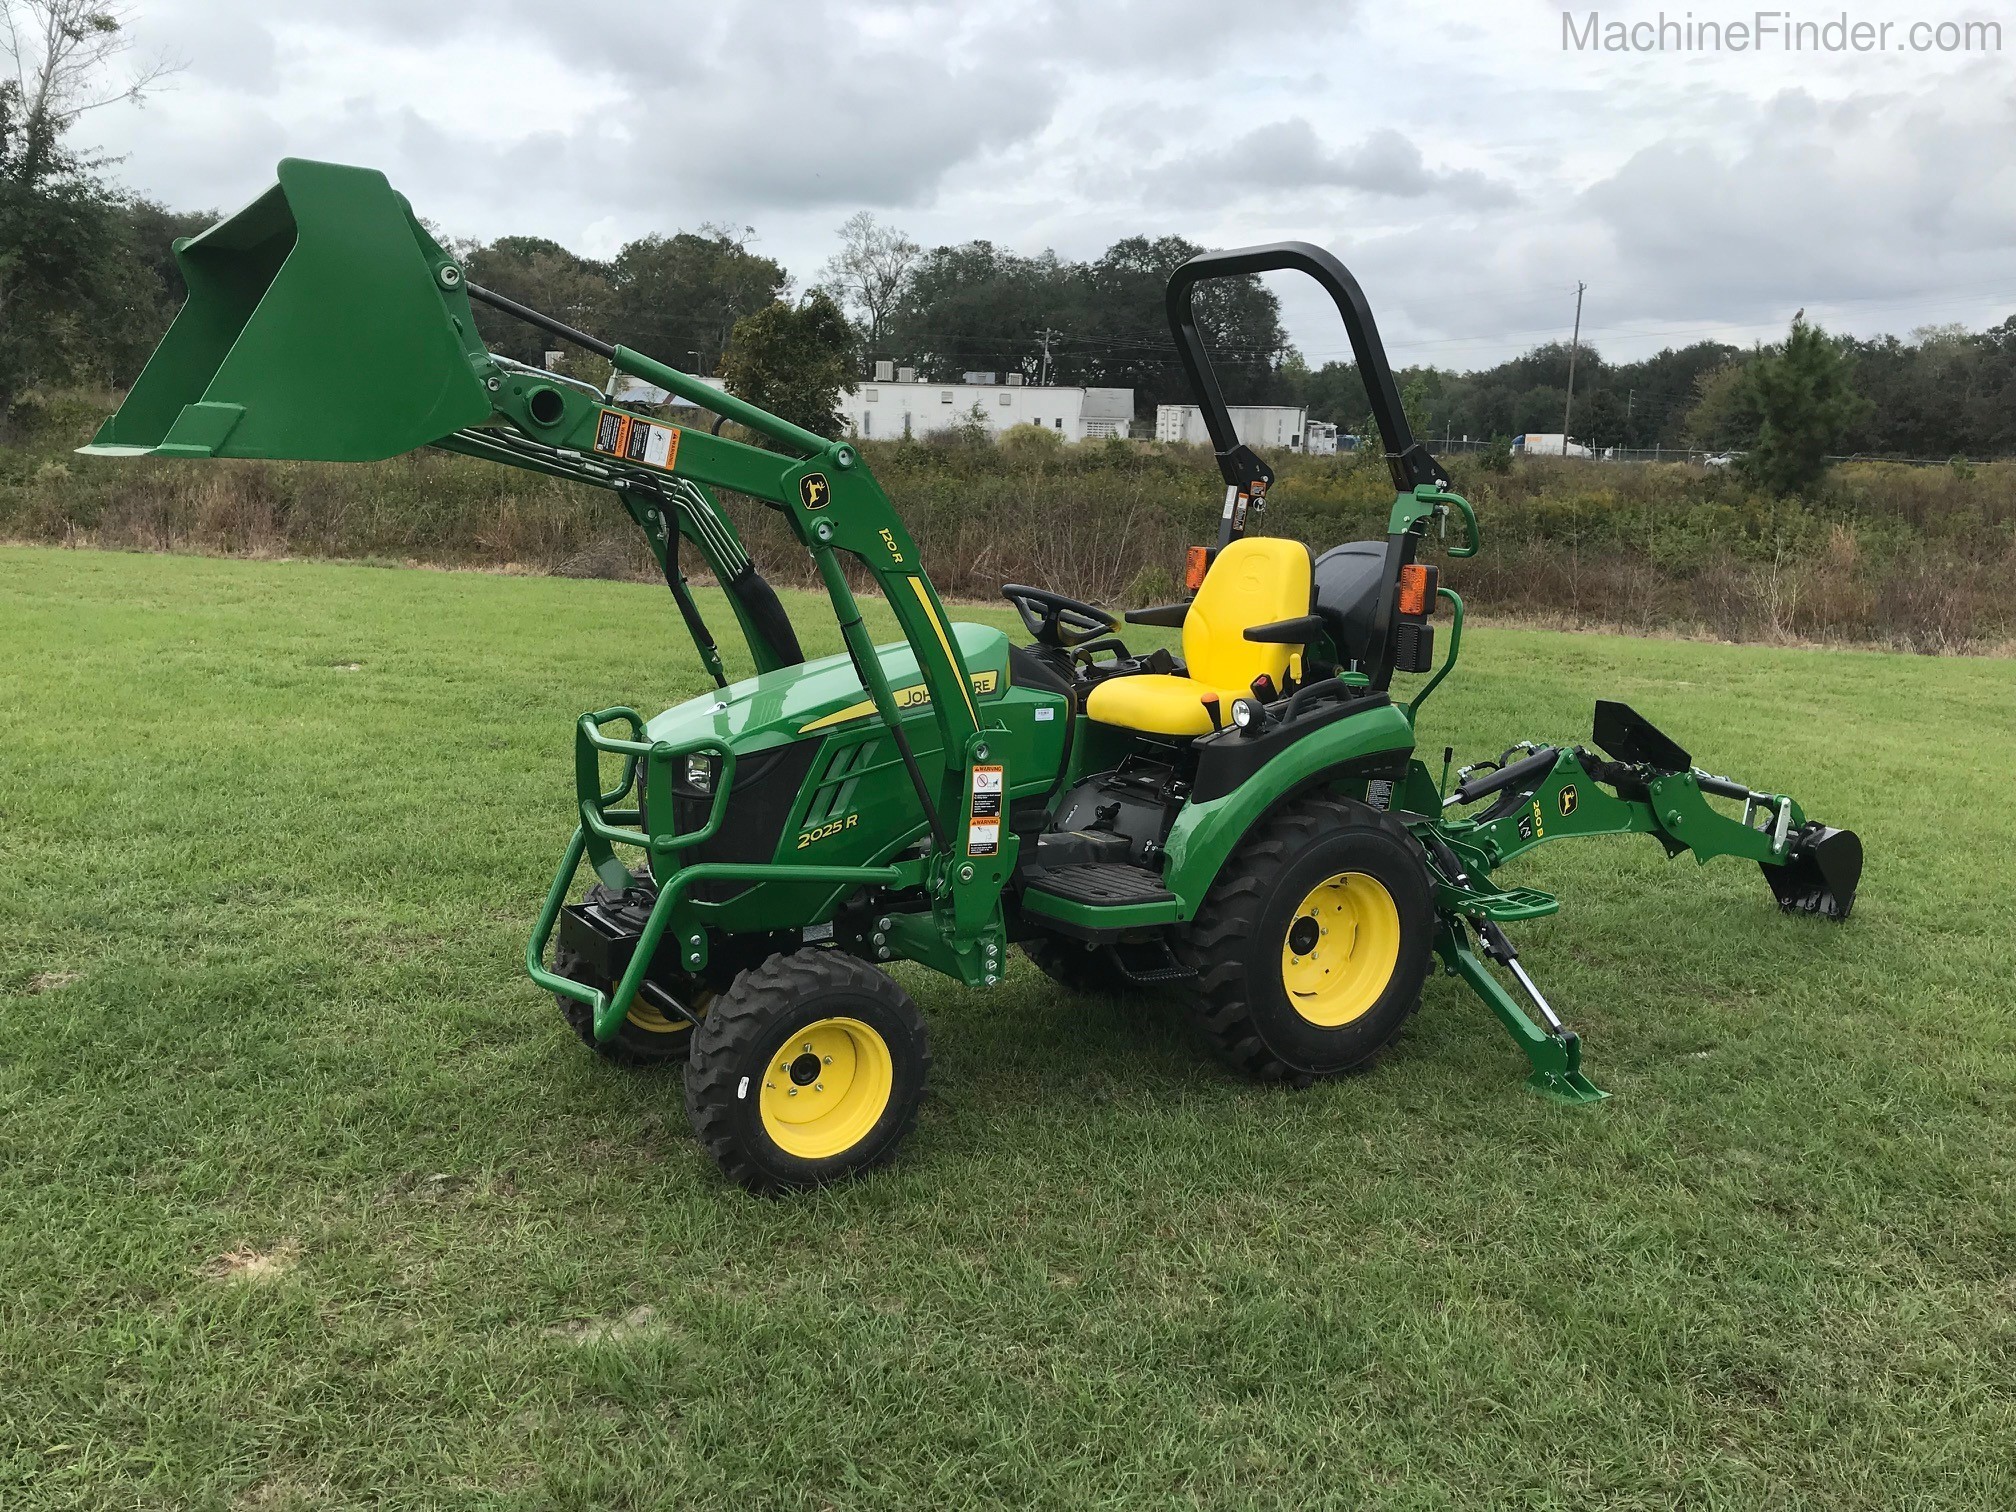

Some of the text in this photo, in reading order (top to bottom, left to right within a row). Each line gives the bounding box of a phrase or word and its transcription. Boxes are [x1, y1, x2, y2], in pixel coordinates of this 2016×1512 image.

[617, 425, 627, 453] WARNING
[668, 440, 677, 466] WARNING
[878, 527, 904, 563] 120 R
[903, 690, 931, 705] JOH
[797, 814, 858, 850] 2025 R
[1532, 799, 1544, 838] 260 B
